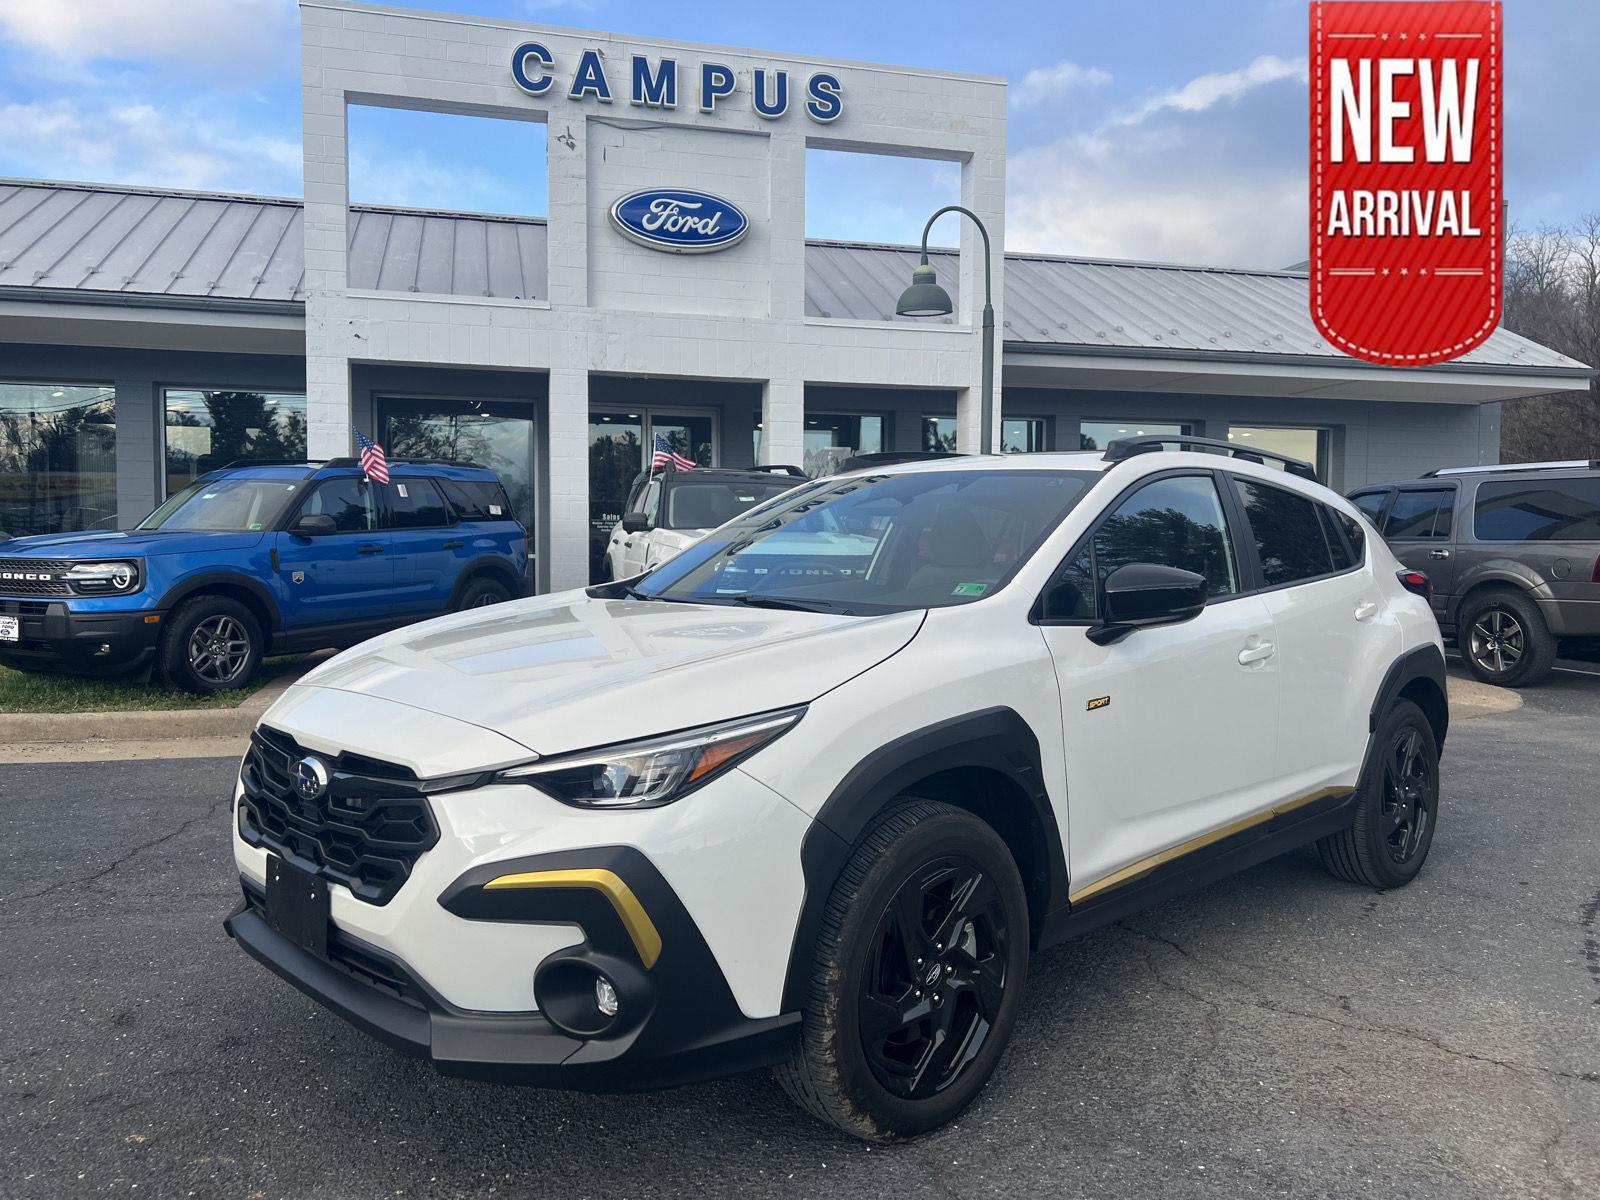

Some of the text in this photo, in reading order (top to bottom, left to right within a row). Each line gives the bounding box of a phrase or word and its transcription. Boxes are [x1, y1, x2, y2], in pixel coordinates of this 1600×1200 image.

[510, 41, 845, 124] CAMPUS
[641, 198, 721, 236] Ford
[602, 513, 620, 521] Sales
[0, 572, 51, 581] ONCO
[1089, 697, 1109, 709] SPORT
